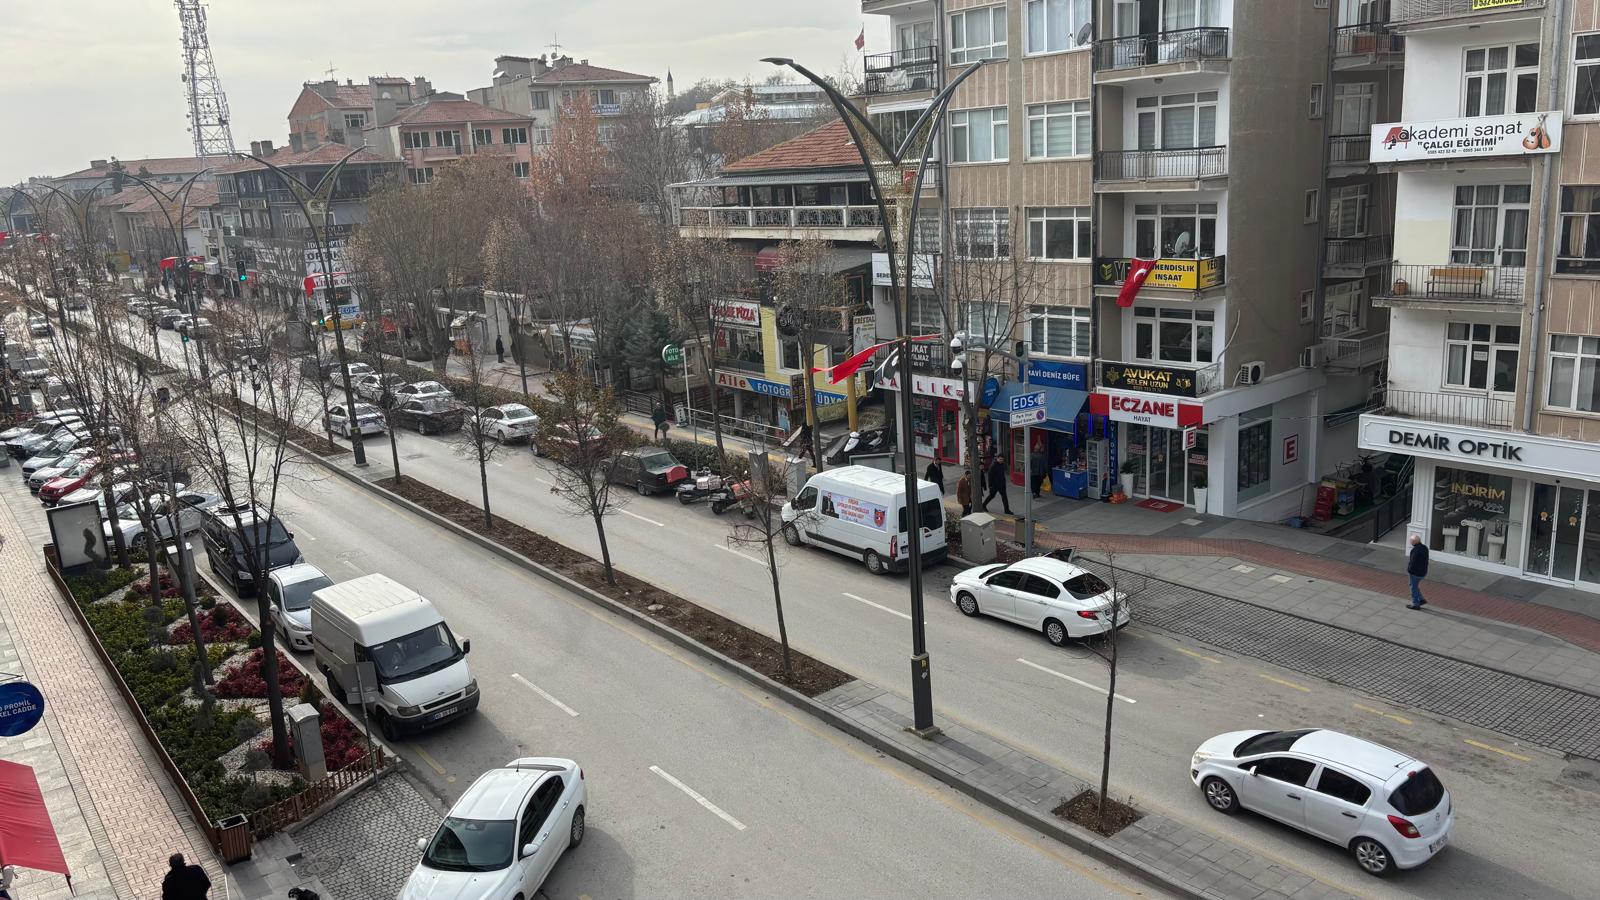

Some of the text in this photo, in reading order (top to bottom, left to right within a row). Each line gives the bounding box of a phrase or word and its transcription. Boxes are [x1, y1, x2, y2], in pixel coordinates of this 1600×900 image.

[1399, 120, 1522, 141] akademi sanat
[665, 347, 679, 355] FOTO
[718, 374, 747, 388] Aile
[1042, 370, 1061, 379] DENİZ
[1122, 368, 1173, 382] AVUKAT
[1126, 378, 1169, 389] SELEN UZUN
[1012, 396, 1034, 410] EDS
[1111, 395, 1174, 417] ECZANE
[1133, 415, 1151, 423] HAYAT
[1187, 431, 1194, 446] E
[1286, 439, 1295, 460] E
[1388, 430, 1523, 462] DEMİR OPTİK
[4, 700, 31, 711] PROMİL
[12, 704, 37, 715] CADDE
